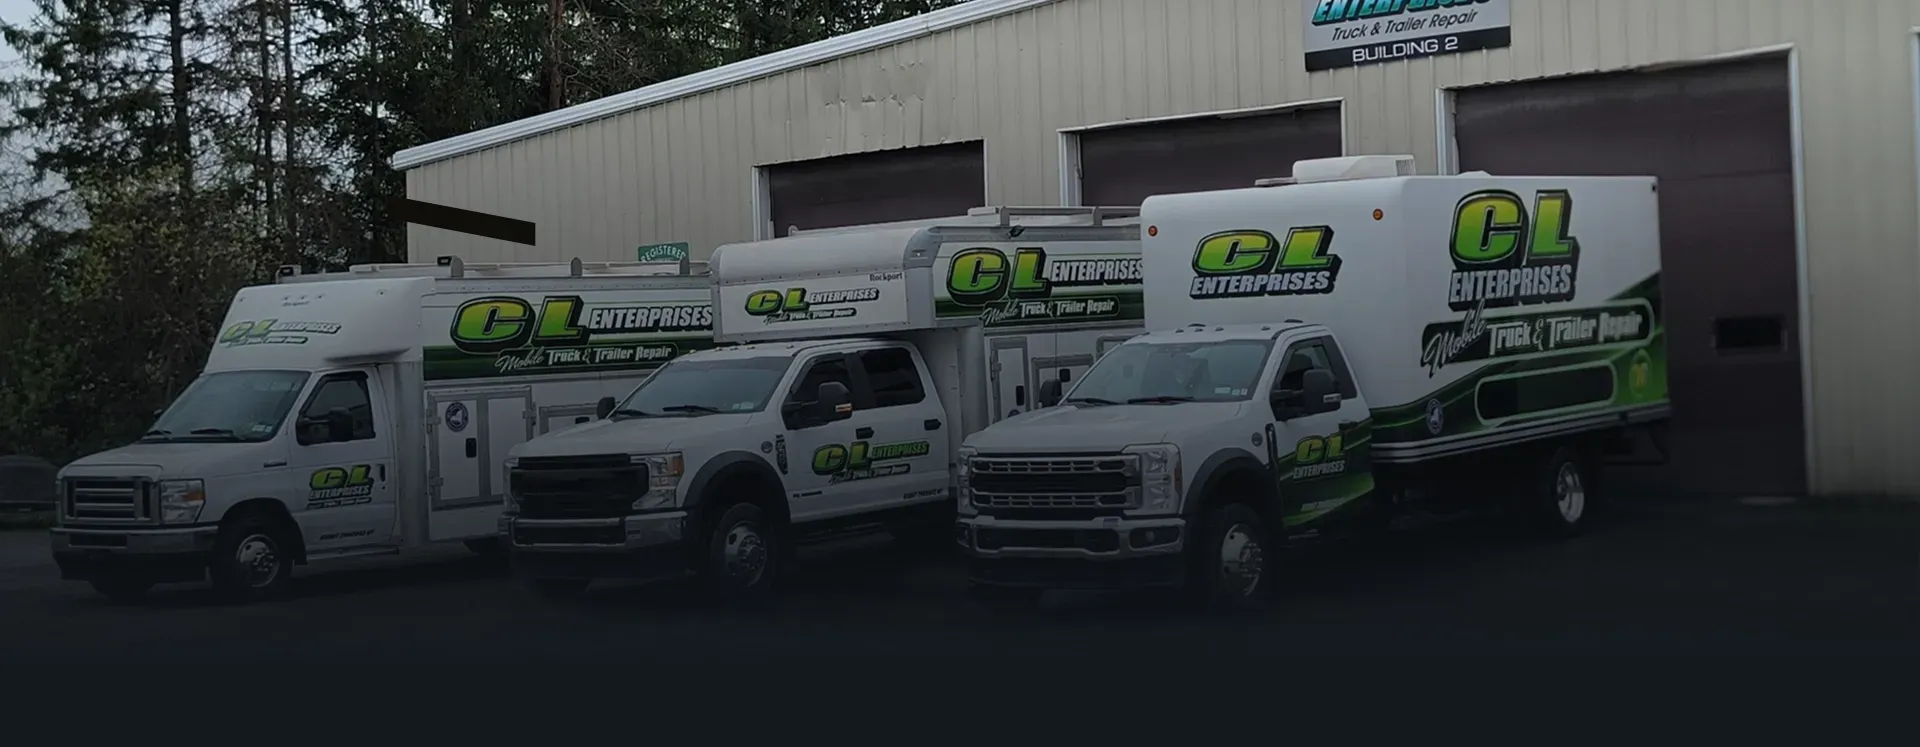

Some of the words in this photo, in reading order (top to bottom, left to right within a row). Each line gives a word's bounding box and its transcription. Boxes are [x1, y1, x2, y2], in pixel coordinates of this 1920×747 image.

[1331, 25, 1366, 41] Truck
[1370, 22, 1381, 36] &
[1385, 16, 1427, 33] Trailer
[1429, 9, 1478, 29] Repair
[1352, 38, 1438, 62] BUILDING
[1445, 36, 1458, 50] 2
[1450, 190, 1580, 268] CL
[1192, 226, 1342, 275] CL
[869, 272, 902, 283] Rockport
[947, 248, 1051, 302] CL
[1050, 259, 1143, 285] ENTERPRISES
[1190, 270, 1334, 299] ENTERPRISES
[1449, 264, 1574, 308] ENTERPRISES
[745, 288, 810, 316] CL
[809, 288, 879, 305] ENTERPRISES
[1020, 302, 1046, 318] Truck
[1055, 301, 1086, 316] Trailer
[1087, 299, 1115, 315] Repair
[450, 296, 592, 353] CL
[589, 305, 712, 333] ENTERPRISES
[1421, 299, 1487, 378] Mobile
[1486, 319, 1530, 358] Truck
[1532, 317, 1545, 350] &
[1547, 316, 1596, 348] Trailer
[1599, 312, 1643, 343] Repair
[494, 346, 545, 373] Mobile
[546, 349, 581, 366] Truck
[582, 347, 591, 364] &
[593, 347, 633, 363] Trailer
[635, 345, 672, 361] Repair
[812, 441, 871, 475] CL
[1296, 434, 1347, 464] CL
[309, 465, 374, 491] CL
